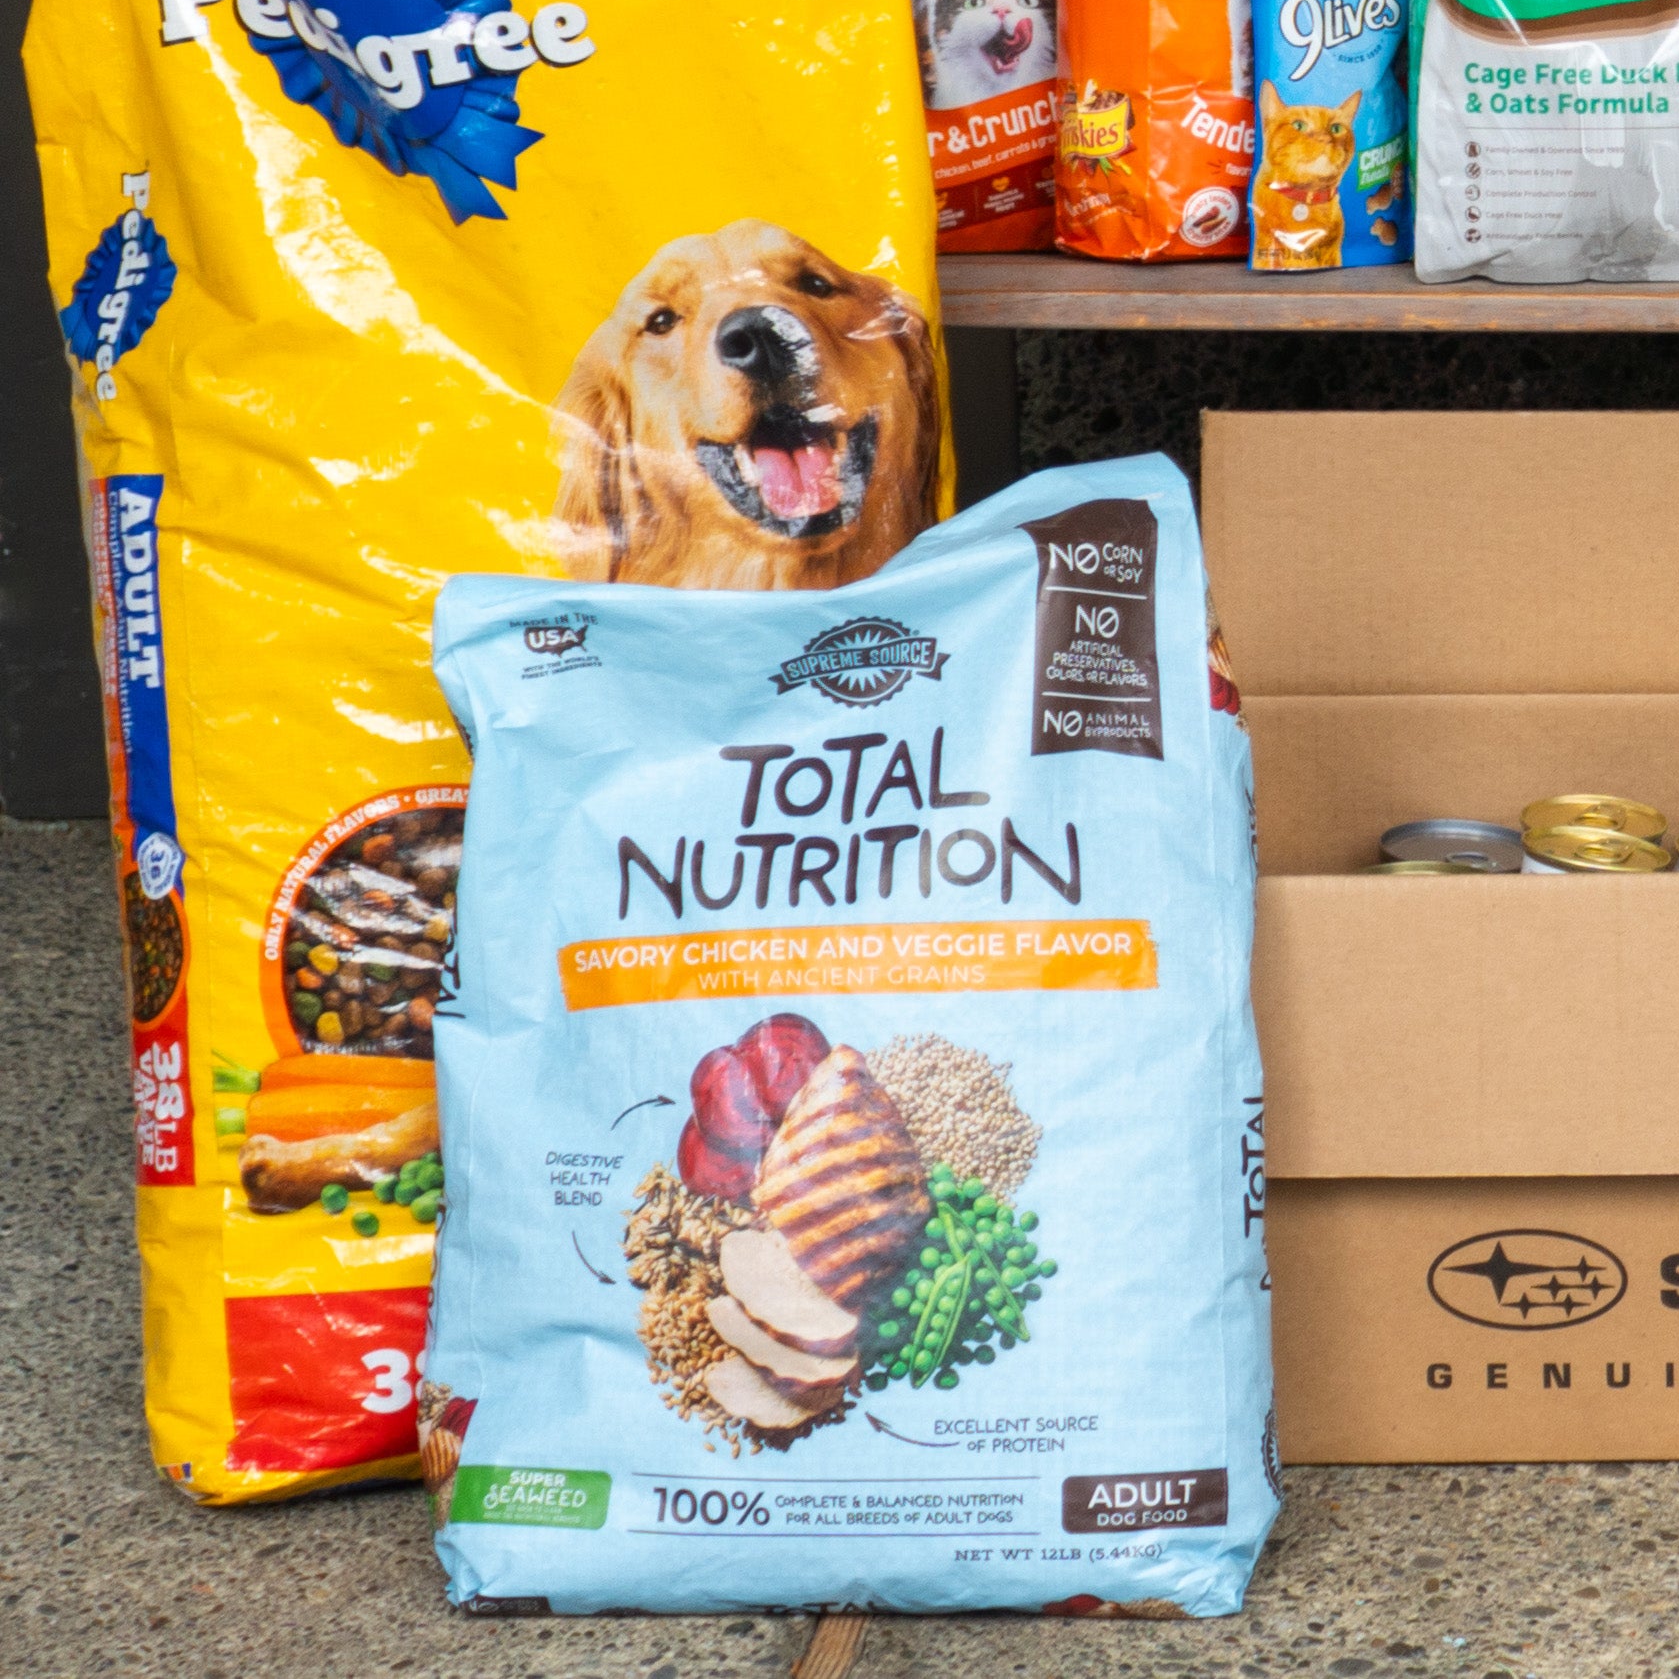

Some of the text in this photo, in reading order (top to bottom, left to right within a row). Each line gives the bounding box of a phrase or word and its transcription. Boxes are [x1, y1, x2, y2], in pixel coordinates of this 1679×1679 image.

[1465, 62, 1530, 89] Cage
[1535, 63, 1592, 85] Free
[1601, 63, 1667, 85] Duck
[1465, 92, 1669, 114] & Oats Formula
[94, 167, 151, 404] Pedigree
[1048, 542, 1143, 575] NO CORN
[119, 487, 160, 689] ADULT
[528, 630, 579, 649] USA
[786, 640, 932, 680] SUPREME SOURCE
[720, 726, 991, 830] TOTAL
[265, 791, 401, 961] ONLY NATURAL FLAVORS
[617, 816, 1083, 922] NUTRITION
[575, 932, 1132, 972] SAVORY CHICKEN AND VEGGIE FLAVOR
[699, 964, 986, 991] WITH ANCIENT GRAINS
[545, 1151, 624, 1169] DIGESTIVE
[550, 1171, 611, 1186] HEALTH
[554, 1190, 603, 1206] BLEND
[933, 1415, 1099, 1435] EXCELLENT SOURCE
[992, 1437, 1065, 1453] PROTEIN
[654, 1487, 770, 1527] 100%
[1088, 1478, 1197, 1510] ADULT
[1096, 1507, 1188, 1528] DOG FOOD
[954, 1542, 1163, 1563] NET WT 12LB (5.44KG)
